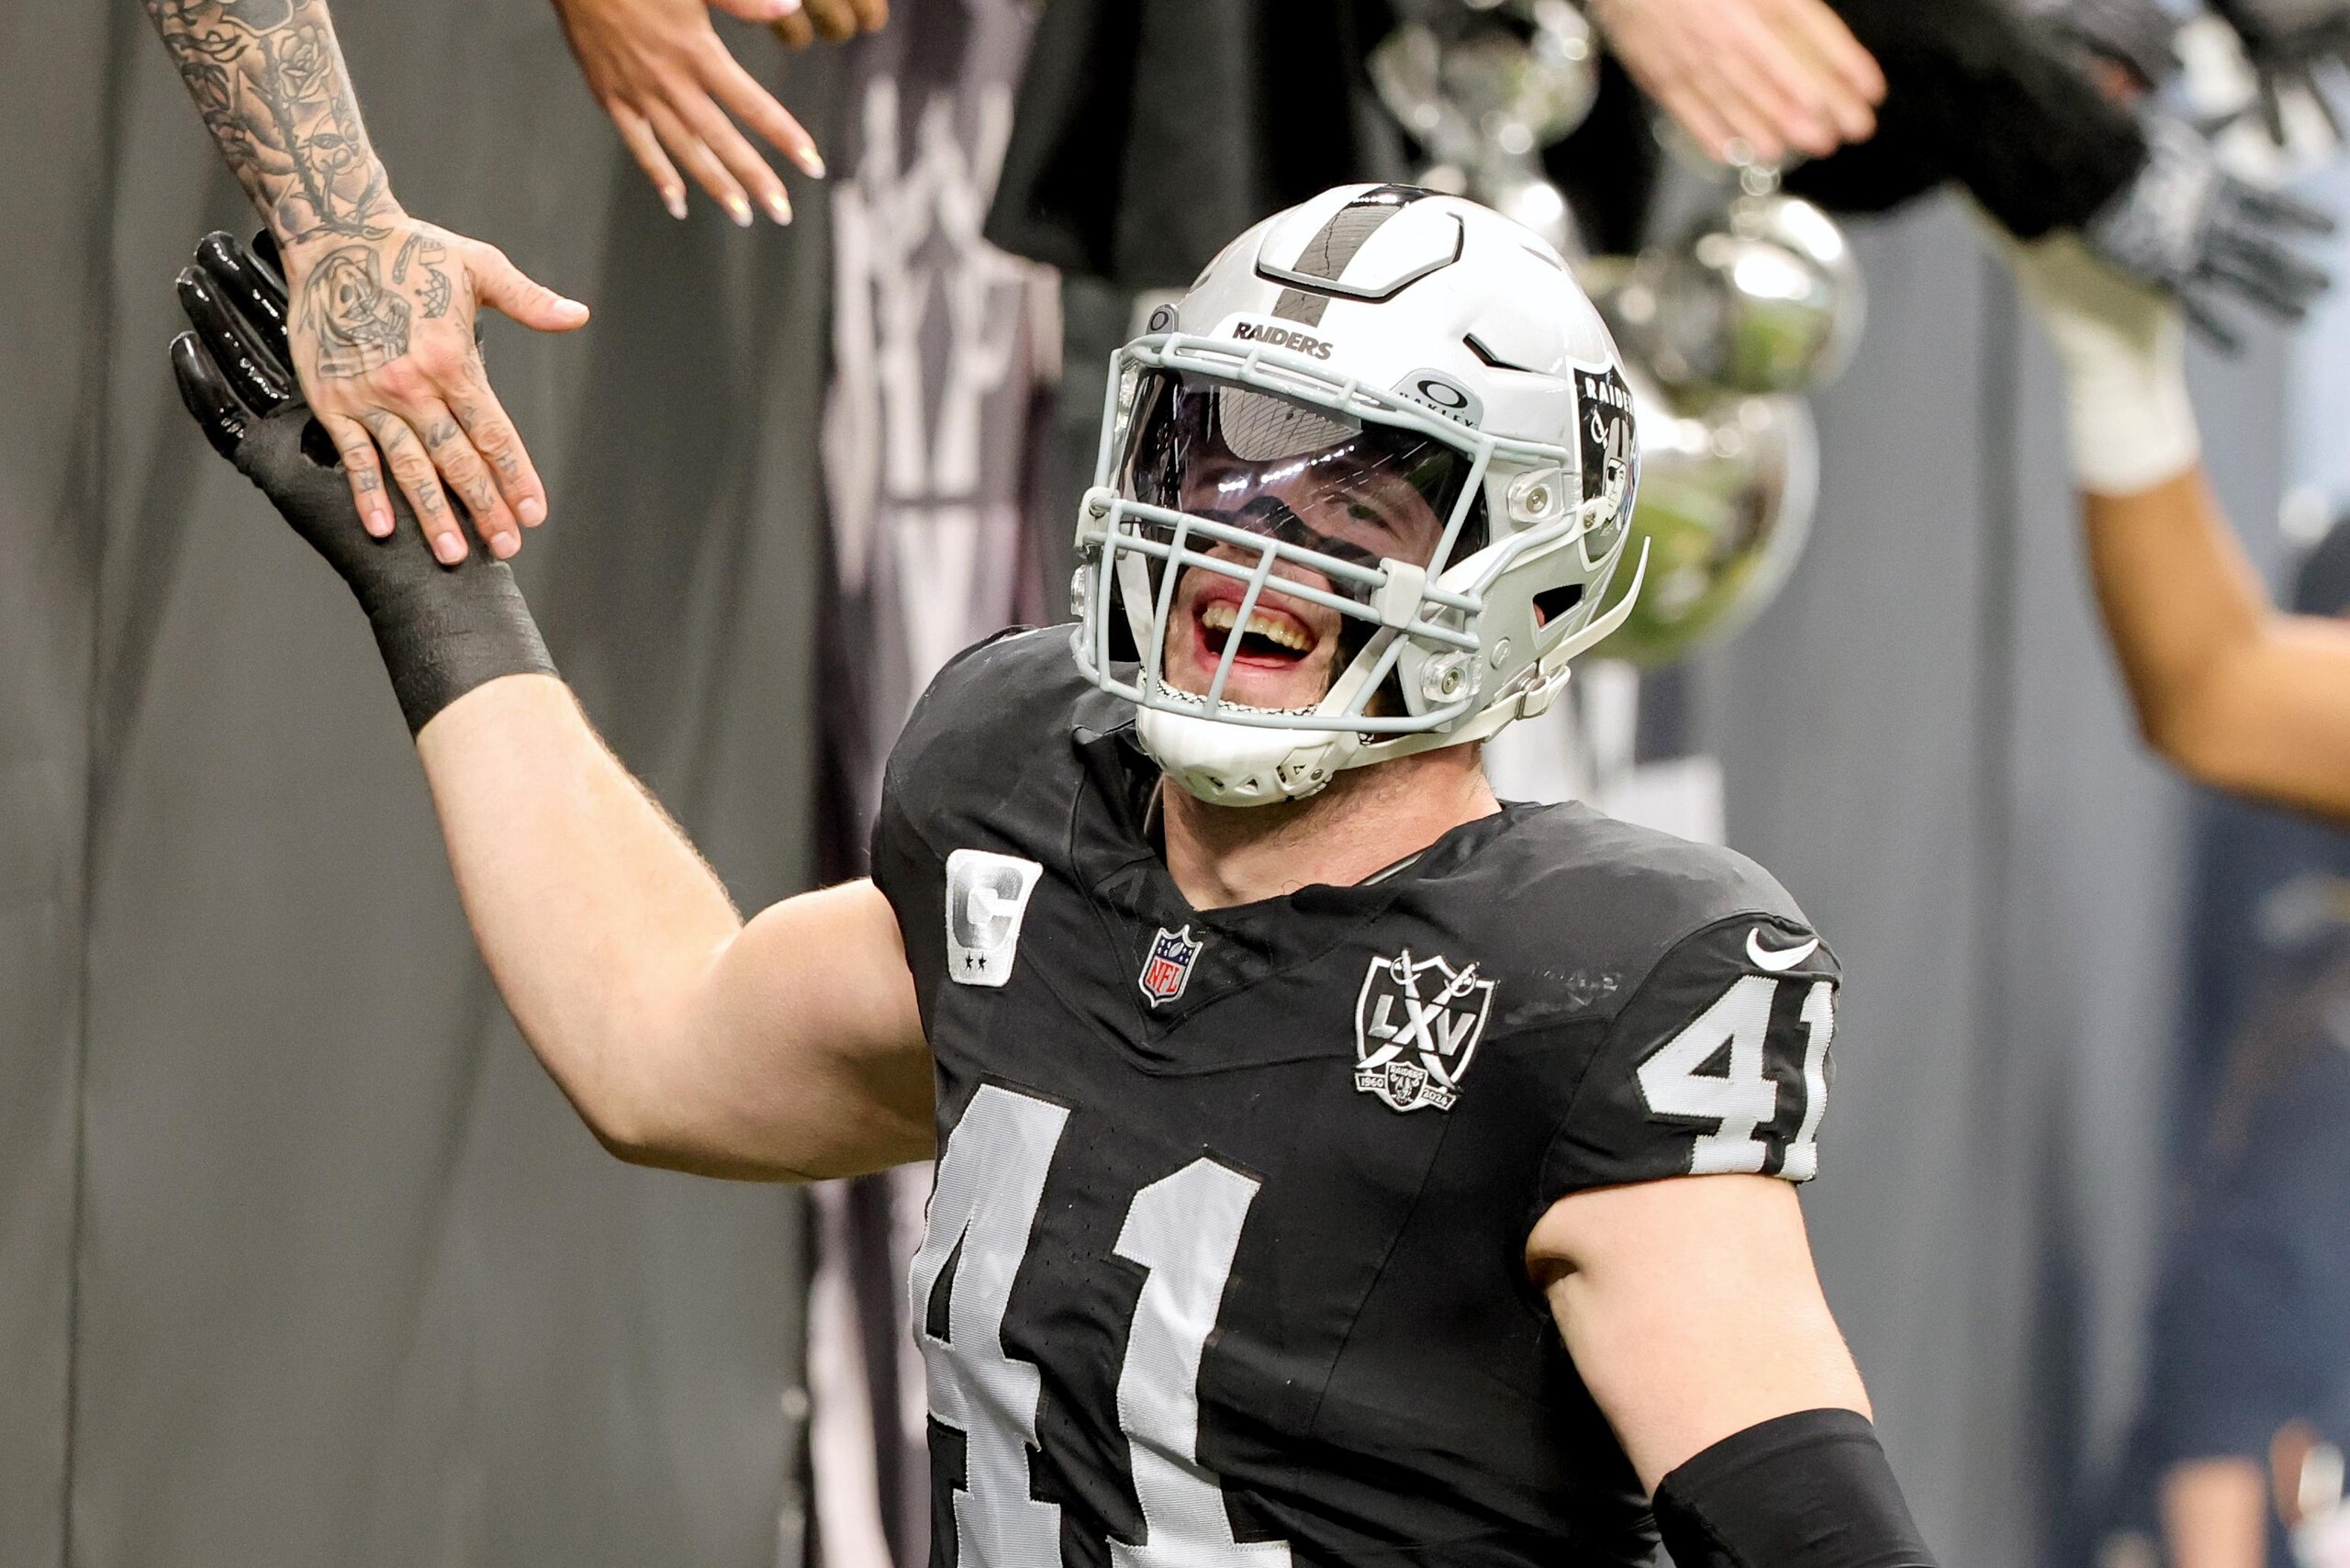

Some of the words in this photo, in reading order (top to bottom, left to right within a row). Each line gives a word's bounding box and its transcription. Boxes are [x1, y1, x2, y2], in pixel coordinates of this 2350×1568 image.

[1232, 321, 1334, 360] RAIDERS
[1147, 959, 1180, 992] NFL
[1368, 994, 1476, 1056] LXV
[1361, 1077, 1384, 1087] 1960
[1422, 1089, 1448, 1105] 2024
[1637, 975, 1834, 1182] 41
[908, 1083, 1292, 1568] 41
